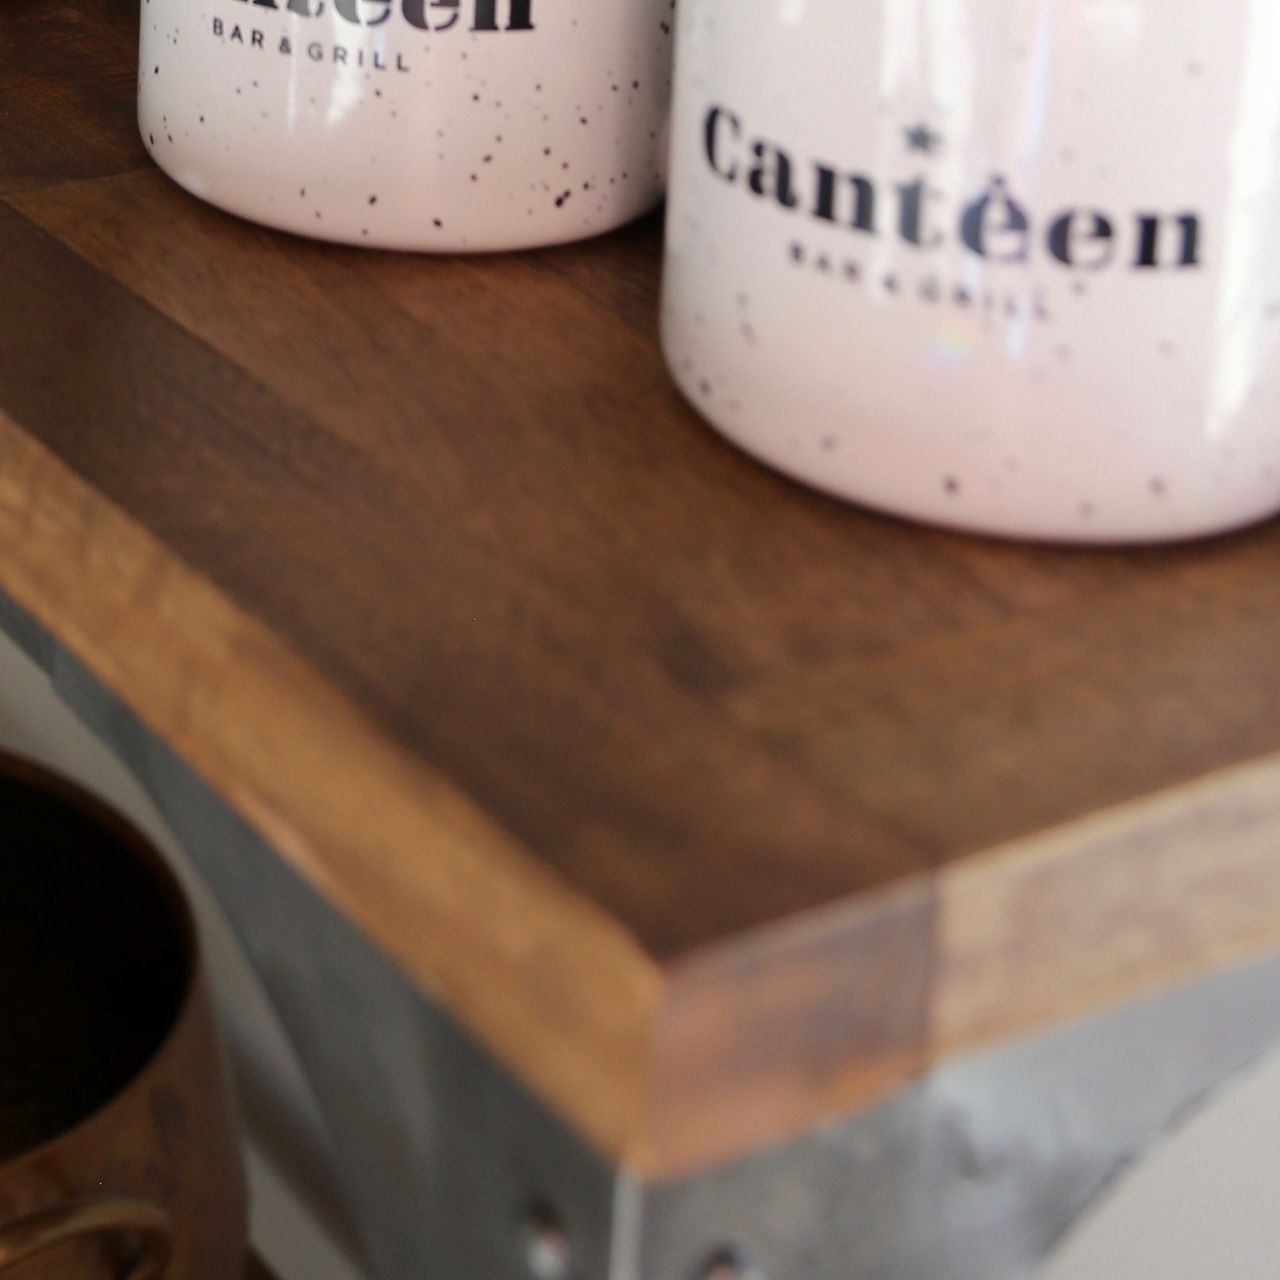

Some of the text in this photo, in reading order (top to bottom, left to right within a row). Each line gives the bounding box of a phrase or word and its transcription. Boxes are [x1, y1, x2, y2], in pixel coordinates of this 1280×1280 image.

[212, 17, 410, 72] BAR & GRILL
[701, 104, 1204, 272] Canteen
